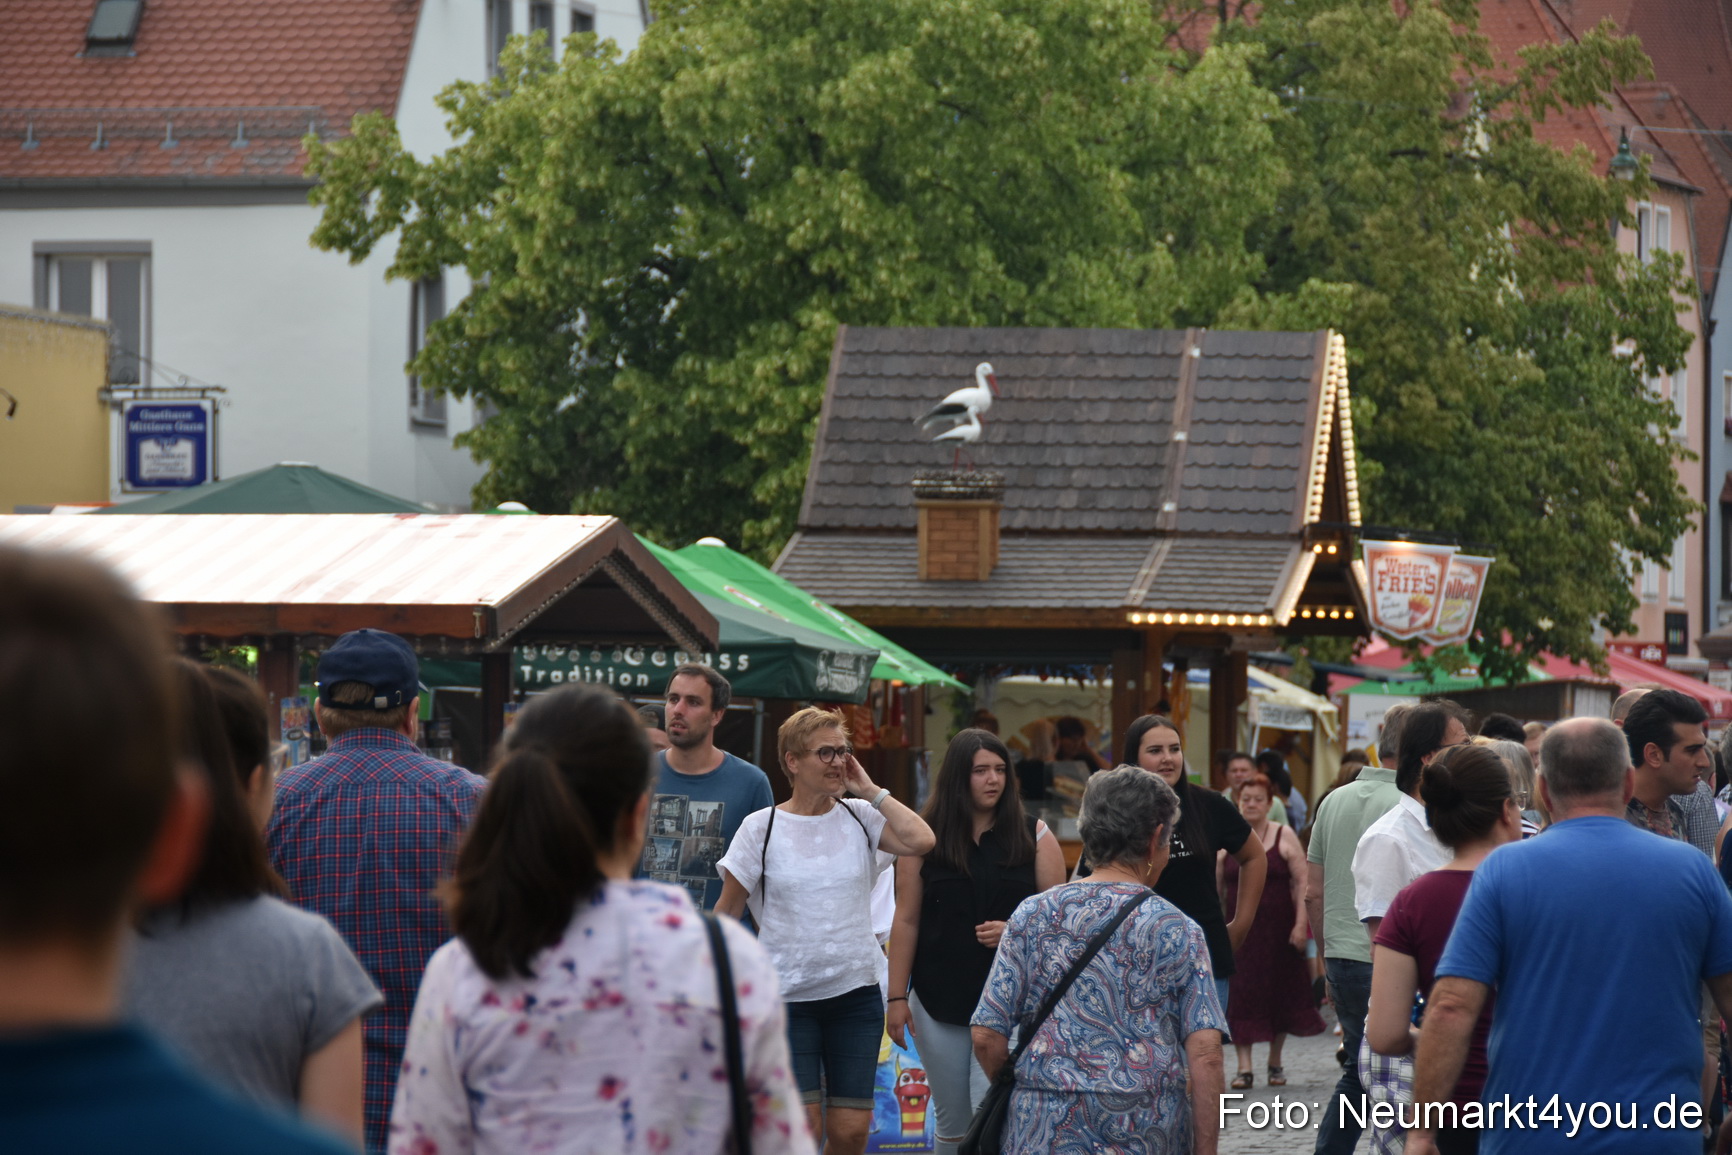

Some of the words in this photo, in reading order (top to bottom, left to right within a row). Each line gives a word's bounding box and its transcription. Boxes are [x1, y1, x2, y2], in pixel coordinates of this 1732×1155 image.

[1385, 557, 1430, 577] Western
[1377, 571, 1436, 595] FRIES
[520, 664, 649, 687] Tradition
